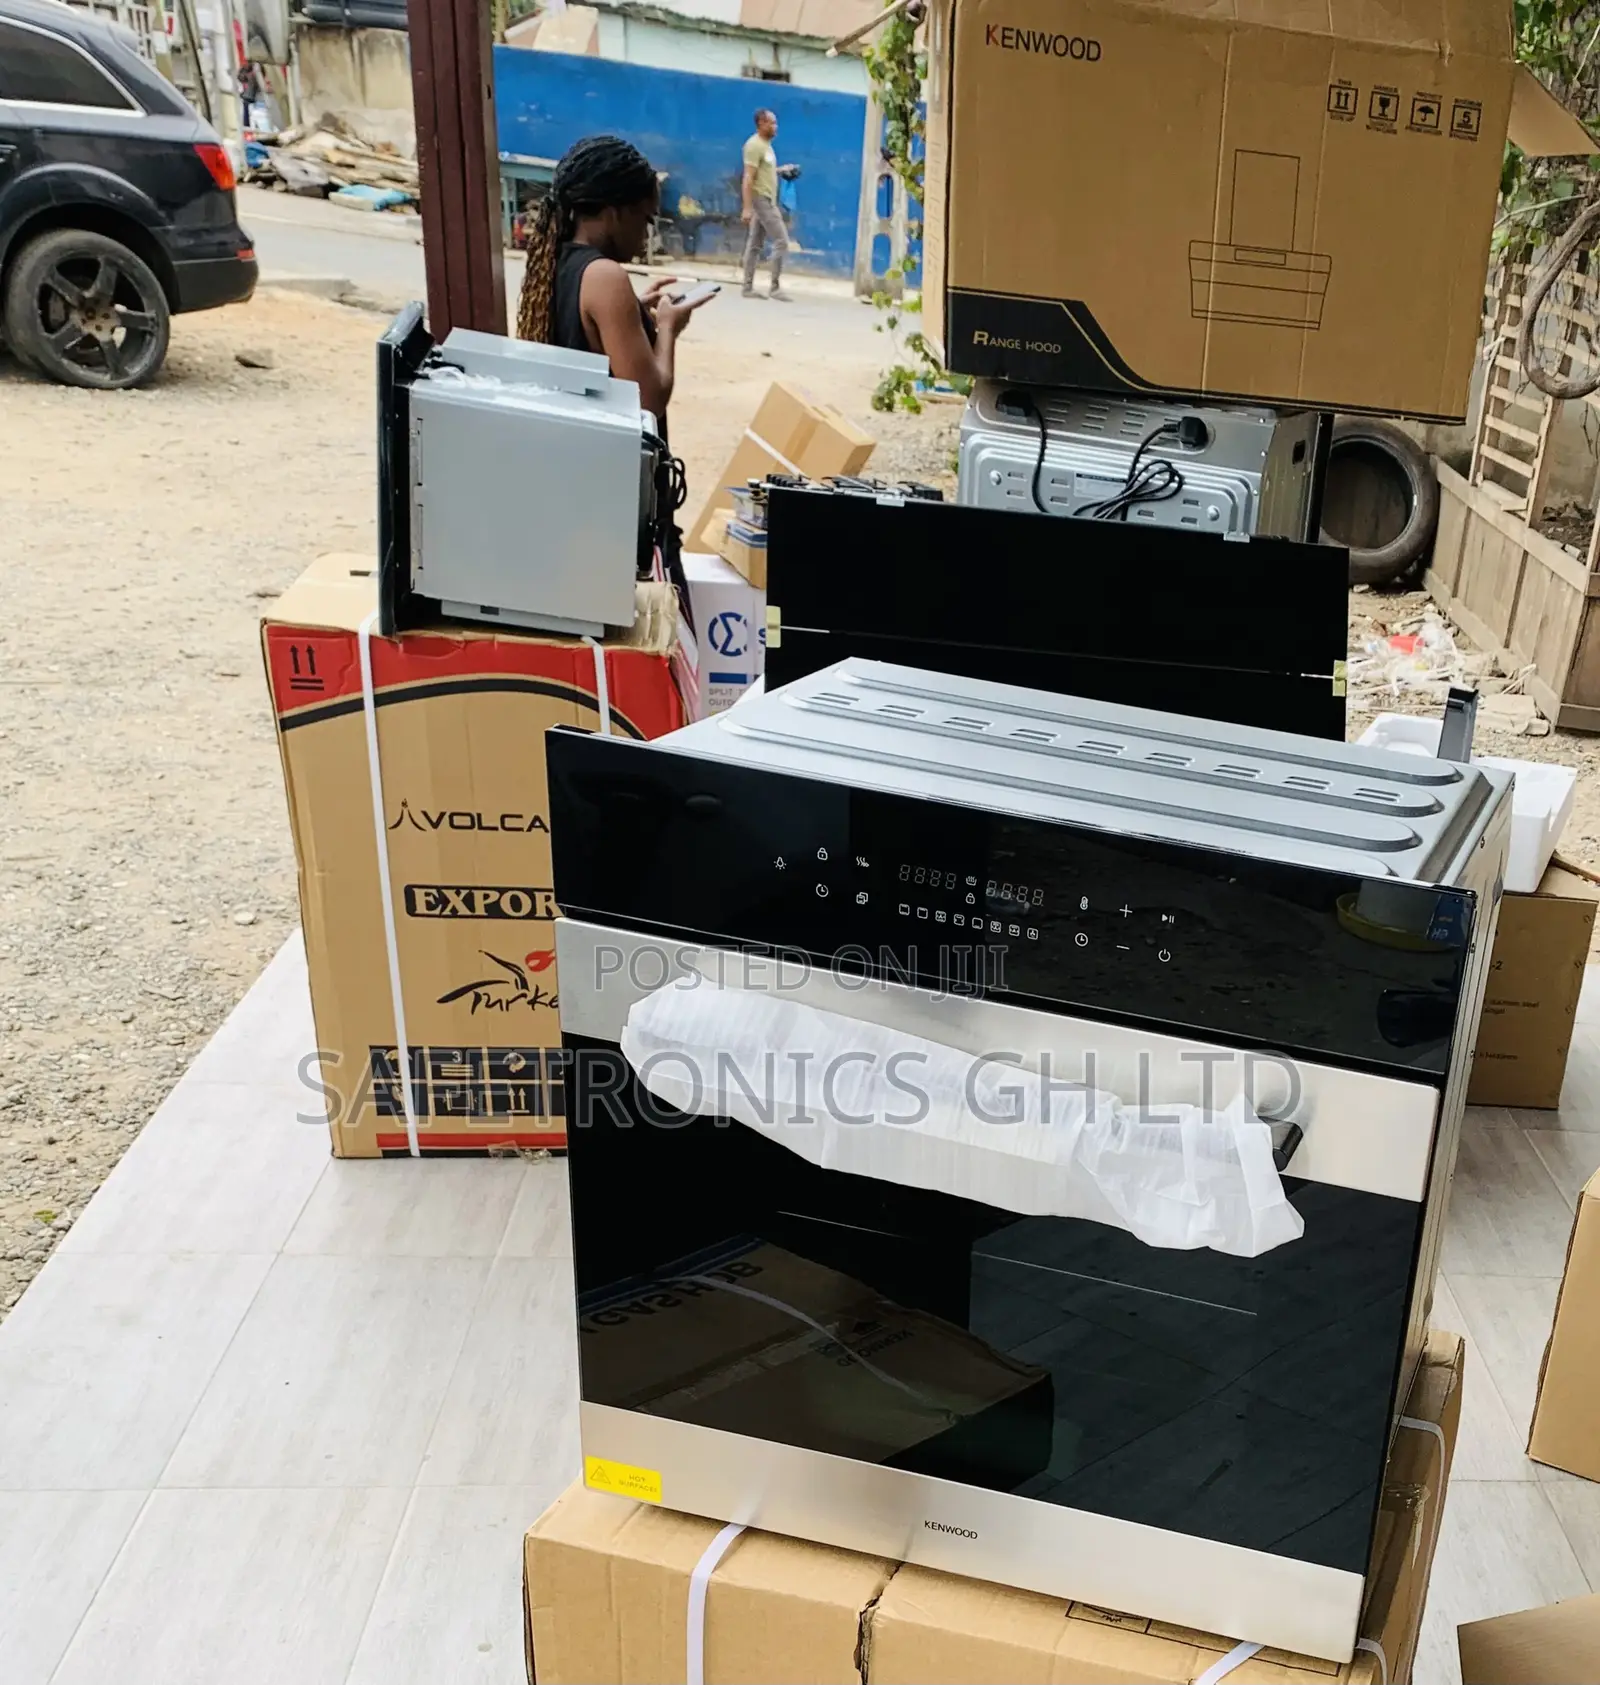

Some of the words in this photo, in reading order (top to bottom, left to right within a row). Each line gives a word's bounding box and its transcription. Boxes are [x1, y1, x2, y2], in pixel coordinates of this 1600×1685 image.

[985, 23, 1102, 62] KENWOOD
[972, 330, 1021, 350] RANGE
[1025, 340, 1062, 354] HOOD
[420, 810, 550, 834] VOLCA
[628, 1473, 646, 1483] HOT
[924, 1520, 978, 1539] KENWOOD
